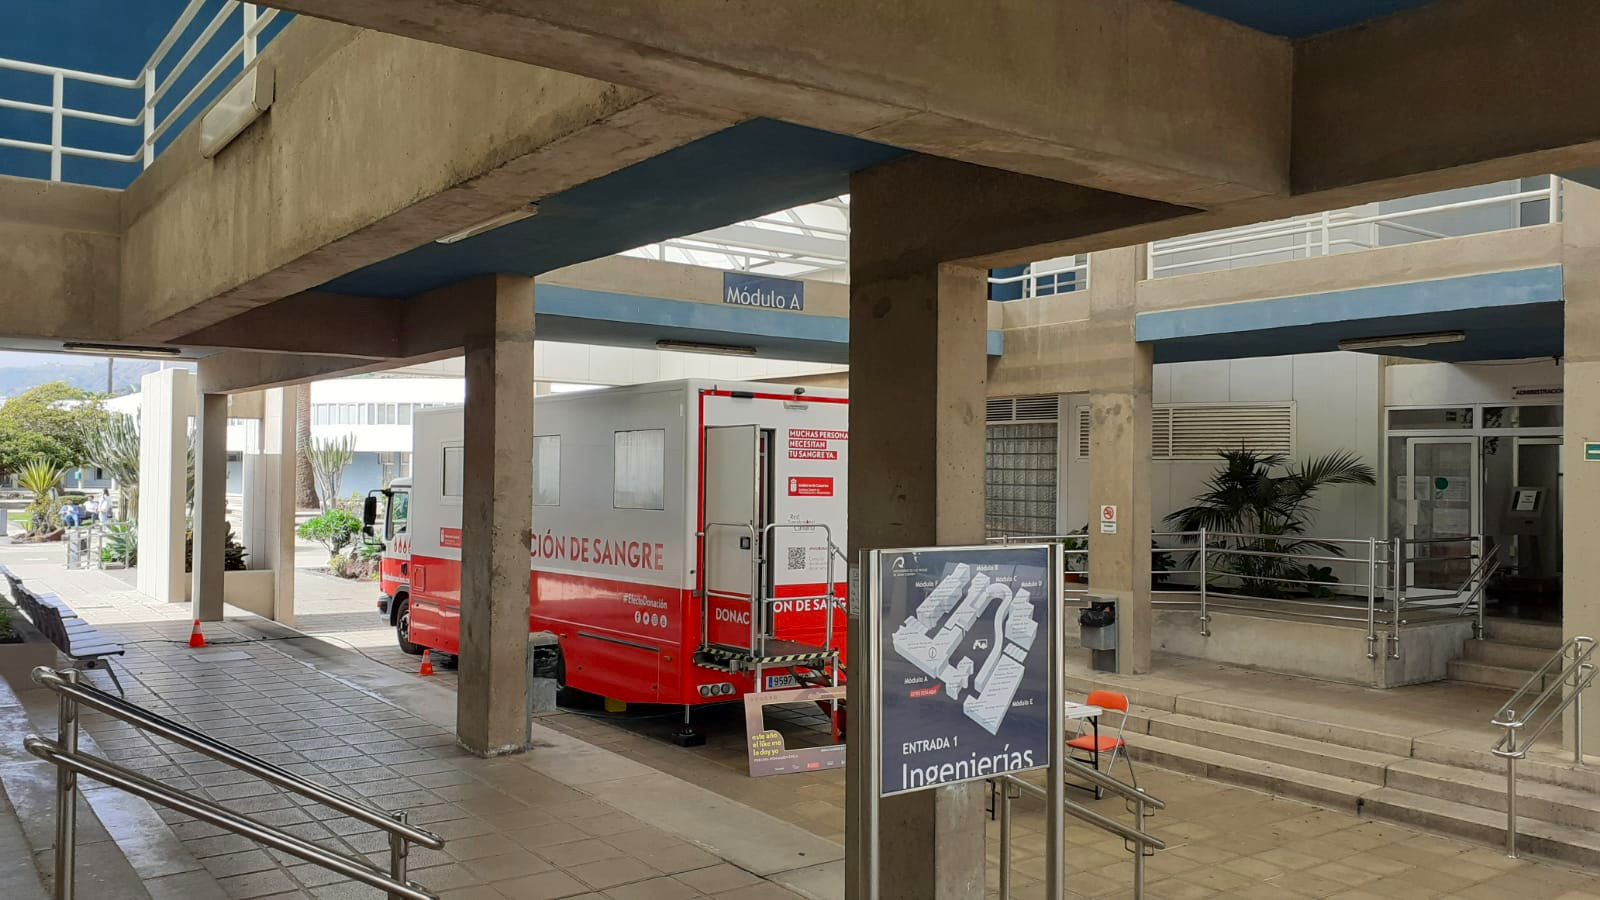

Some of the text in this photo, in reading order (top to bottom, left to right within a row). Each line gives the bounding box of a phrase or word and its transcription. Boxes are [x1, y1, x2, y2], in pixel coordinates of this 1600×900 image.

[726, 286, 800, 310] Módulo A
[790, 430, 819, 438] MUCHAS
[790, 440, 826, 448] NECESITAN
[790, 450, 798, 458] TU
[799, 451, 825, 459] SANGRE
[570, 536, 590, 563] DE
[592, 538, 664, 571] SANGRE
[795, 599, 811, 612] DE
[715, 607, 750, 625] DONAC
[774, 675, 793, 686] 9597
[904, 676, 923, 684] Módulo
[902, 735, 958, 755] ENTRADA 1
[902, 743, 1034, 790] Ingenierías
